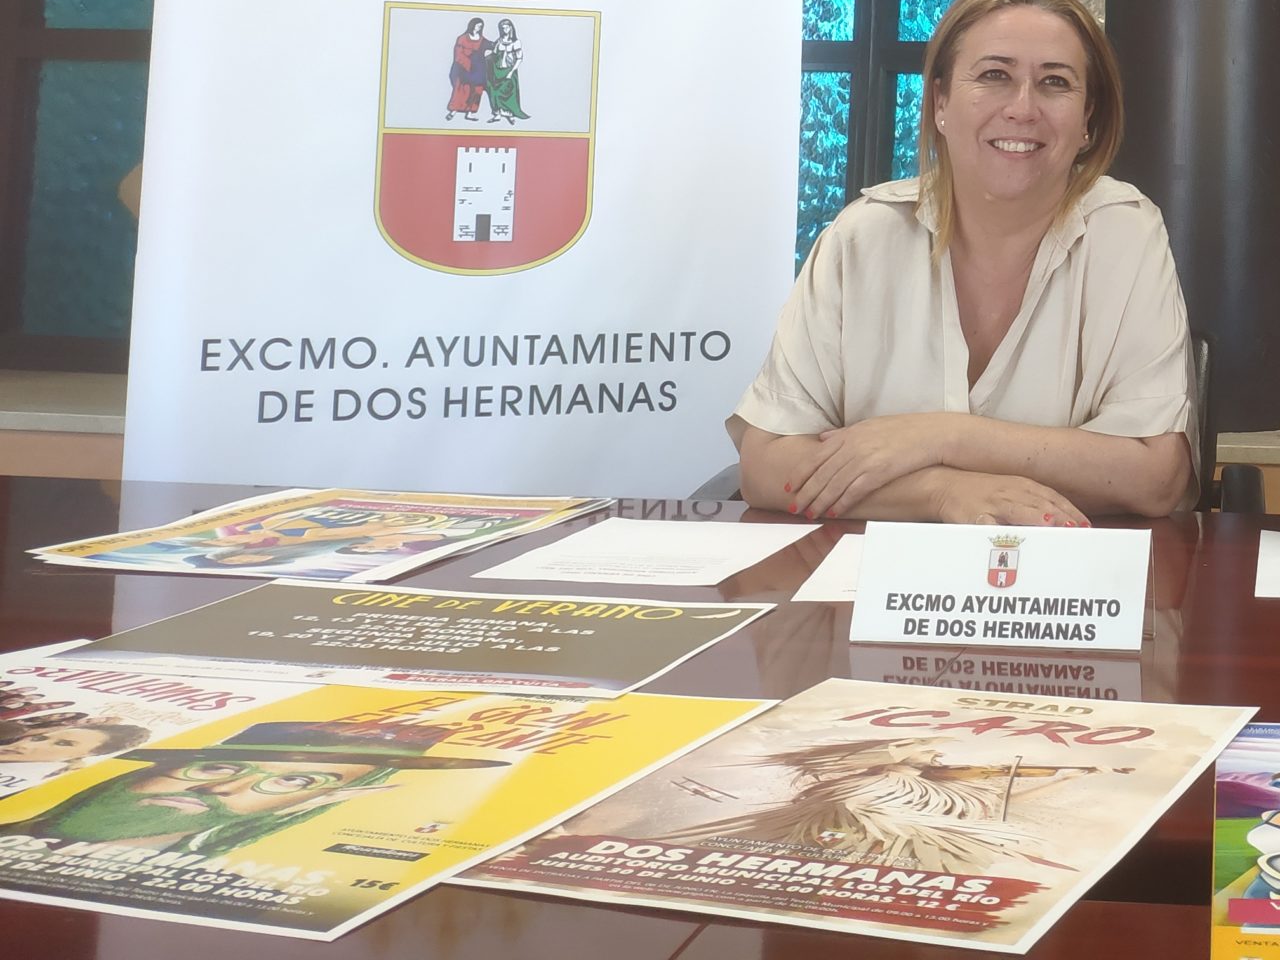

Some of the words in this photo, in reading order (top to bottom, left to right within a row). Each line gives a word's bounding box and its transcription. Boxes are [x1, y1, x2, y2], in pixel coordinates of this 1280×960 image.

[201, 337, 389, 372] EXCMO.
[404, 330, 731, 368] AYUNTAMIENTO
[257, 390, 315, 424] DE
[332, 387, 427, 422] DOS
[443, 380, 678, 418] HERMANAS
[332, 593, 434, 608] CINE
[433, 600, 483, 610] DE
[492, 600, 684, 620] VERANO
[352, 613, 450, 622] PRIMERA
[886, 592, 956, 613] EXCMO
[961, 595, 1121, 618] AYUNTAMIENTO
[306, 628, 414, 638] SEGUNDA
[421, 627, 501, 636] HORAS
[454, 623, 517, 631] JULIO
[903, 618, 930, 636] DE
[935, 619, 977, 638] DOS
[982, 621, 1097, 642] HERMANAS
[379, 644, 464, 653] HORAS
[410, 640, 480, 648] JULIO
[406, 675, 479, 684] ENTRADA
[479, 679, 560, 687] GRATUITA
[467, 705, 630, 731] GRAN
[953, 697, 1094, 716] STRAD
[0, 834, 62, 852] OS
[51, 841, 336, 886] HERMANAS
[43, 855, 179, 878] MUNICIPAL
[180, 872, 233, 885] LOS
[231, 877, 279, 891] DEL
[585, 840, 694, 862] DOS
[696, 852, 993, 893] HERMANAS
[10, 861, 54, 872] DE
[45, 865, 127, 882] JUNIO
[140, 877, 214, 893] 22.00
[213, 887, 307, 905] HORAS
[529, 859, 607, 872] JUEVES
[606, 867, 635, 875] 30
[636, 870, 668, 880] DE
[668, 873, 736, 885] JUNIO
[753, 882, 814, 894] 22.00
[817, 889, 896, 904] HORAS
[916, 899, 941, 908] 12
[549, 851, 690, 872] AUDITORIO
[692, 866, 835, 887] MUNICIPAL
[843, 879, 894, 893] LOS
[897, 887, 945, 899] DEL
